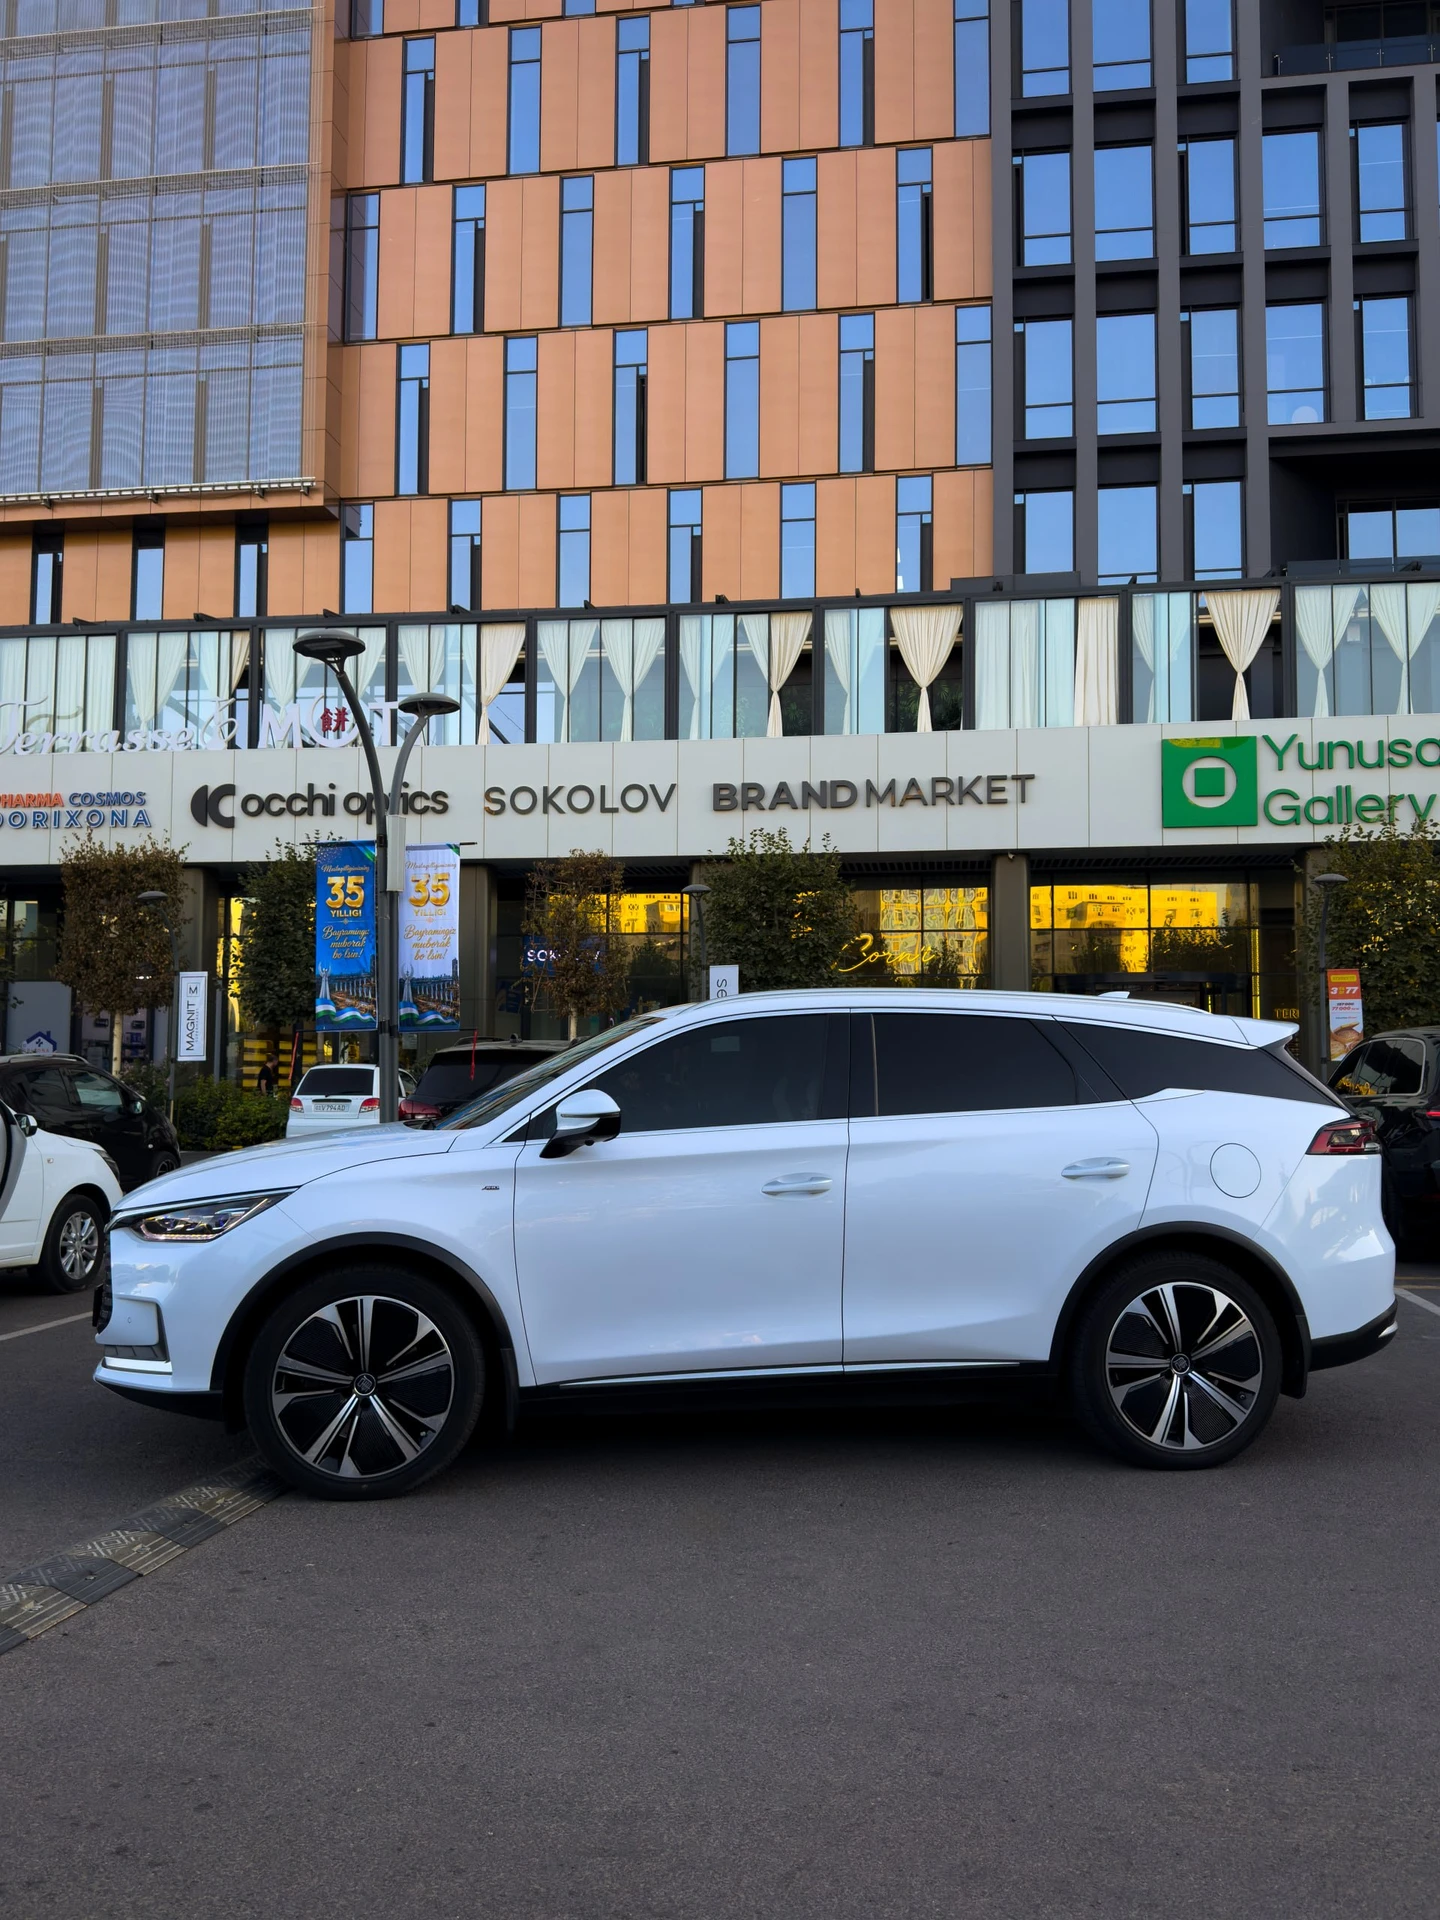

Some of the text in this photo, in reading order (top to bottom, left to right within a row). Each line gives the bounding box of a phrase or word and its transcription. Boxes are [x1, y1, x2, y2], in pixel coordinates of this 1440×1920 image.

[0, 792, 146, 808] HARMA COSMOS
[241, 781, 449, 825] occhi opics
[483, 783, 677, 816] SOKOLOV
[0, 809, 151, 829] ORIXONA
[326, 875, 365, 908] 35
[409, 872, 450, 908] 35
[330, 909, 362, 917] YILLIGI
[186, 1000, 196, 1051] MAGNIT
